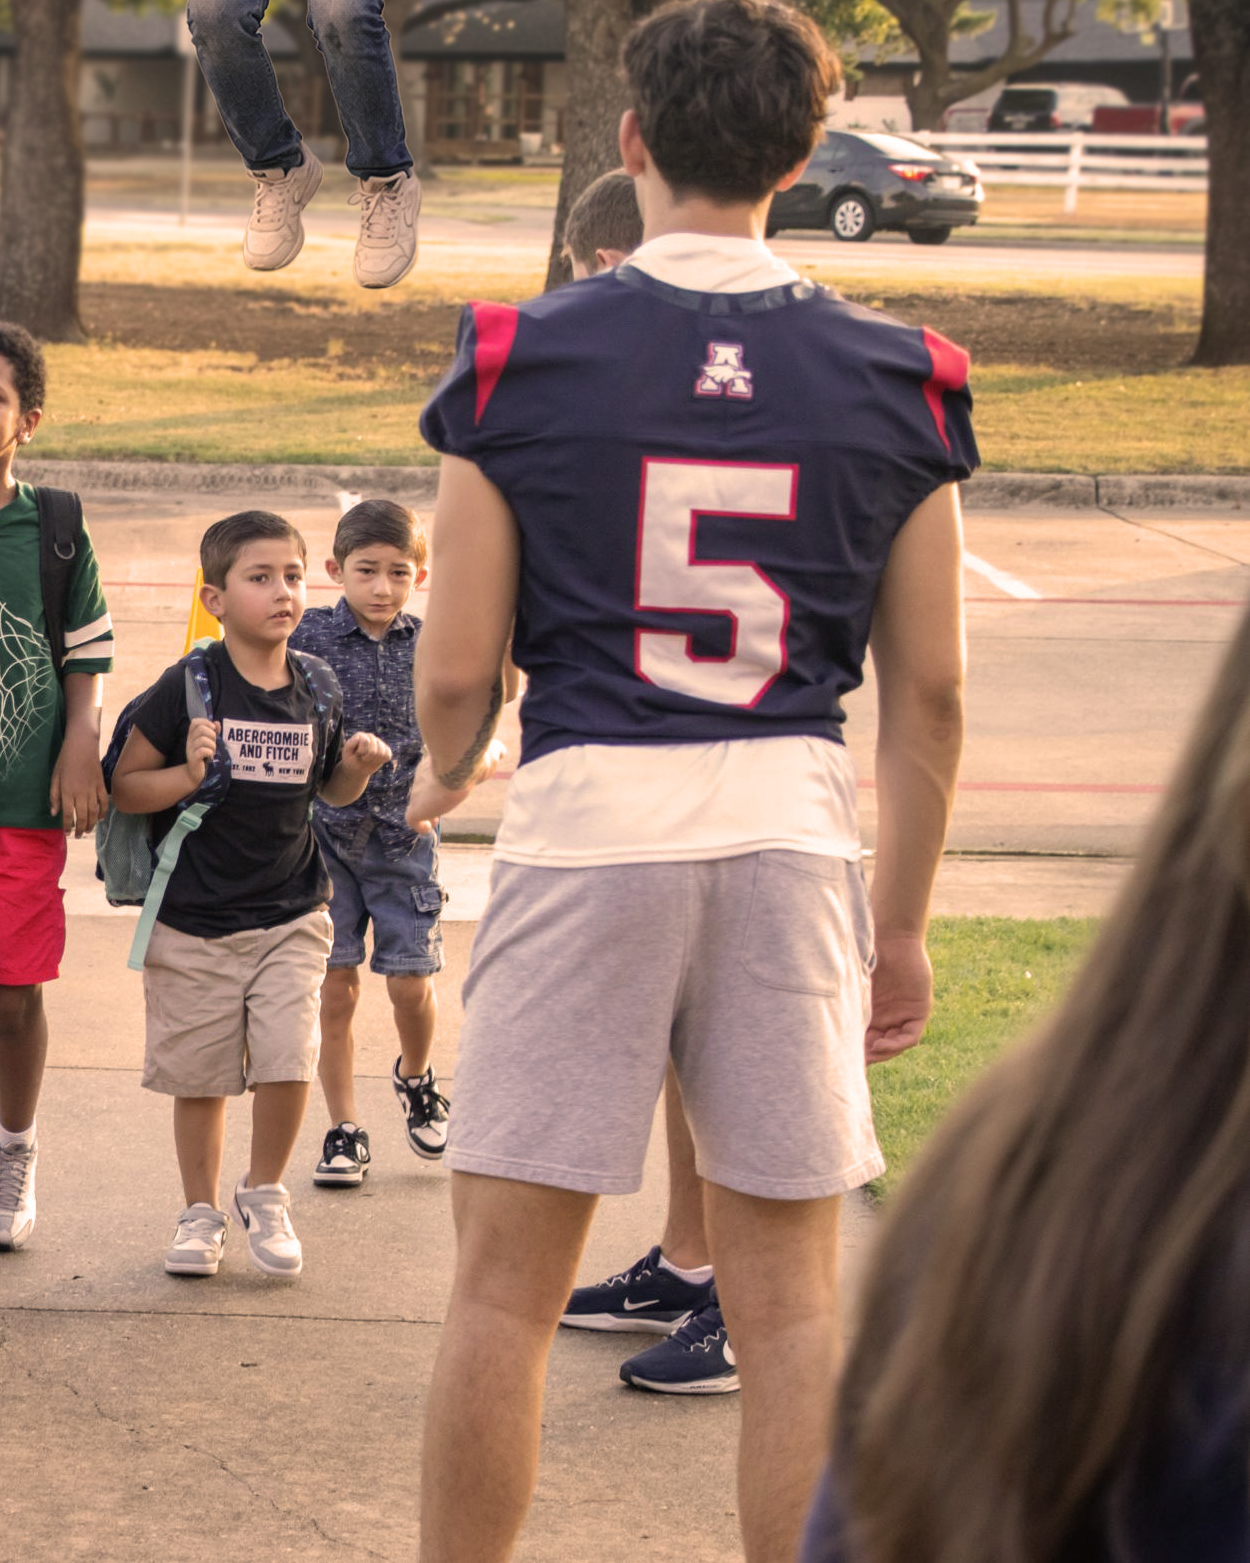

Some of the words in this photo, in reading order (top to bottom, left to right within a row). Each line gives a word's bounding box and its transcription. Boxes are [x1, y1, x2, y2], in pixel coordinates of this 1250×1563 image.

[695, 342, 753, 399] A
[634, 456, 800, 709] 5
[227, 727, 309, 747] ABERCROMBIE
[239, 743, 262, 759] AND
[266, 746, 299, 761] FITCH
